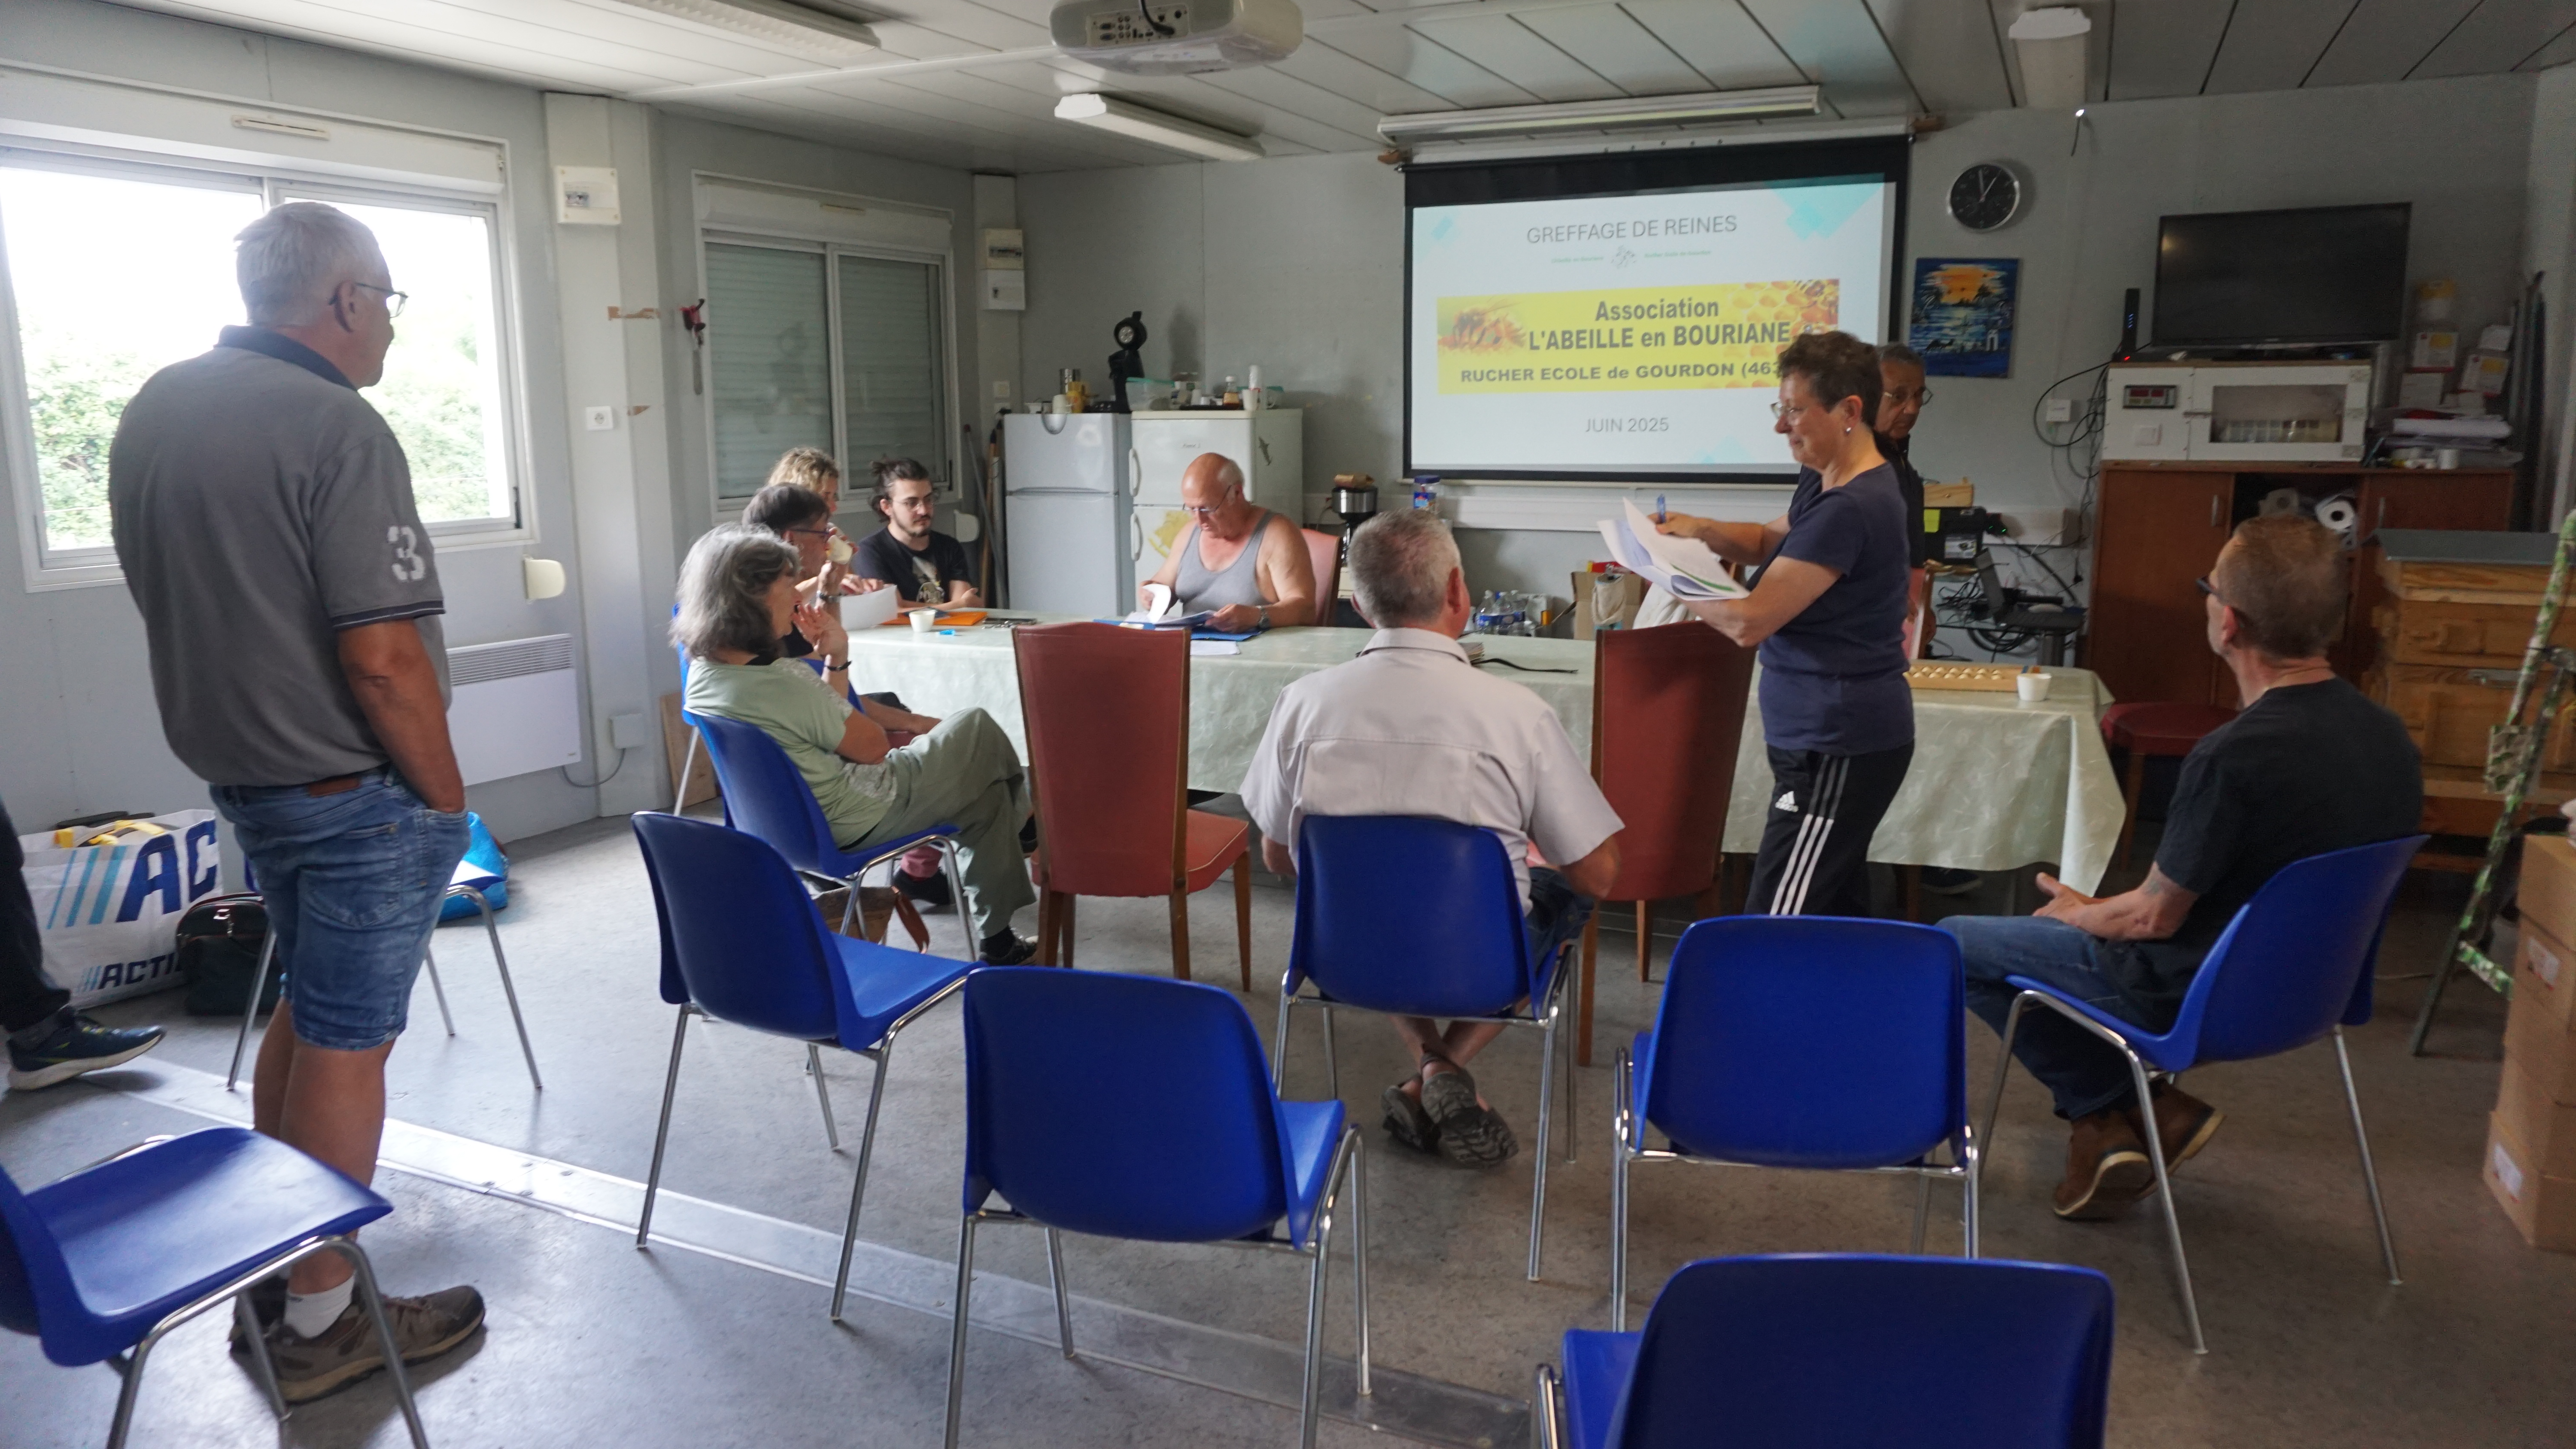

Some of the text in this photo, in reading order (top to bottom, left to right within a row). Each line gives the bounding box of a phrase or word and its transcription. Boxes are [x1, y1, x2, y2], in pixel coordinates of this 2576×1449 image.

[1527, 215, 1738, 243] GREFFAGE DE REINES
[1595, 297, 1719, 321] Association
[1529, 322, 1790, 350] L'ABEILLE en BOURIANE
[1461, 368, 1534, 382] RUCHER
[1541, 367, 1601, 381] ECOLE
[1607, 366, 1629, 379] de
[1636, 363, 1733, 379] GOURDON
[1586, 417, 1669, 432] JUIN 2025
[387, 525, 425, 582] 3
[99, 952, 183, 989] ACTI
